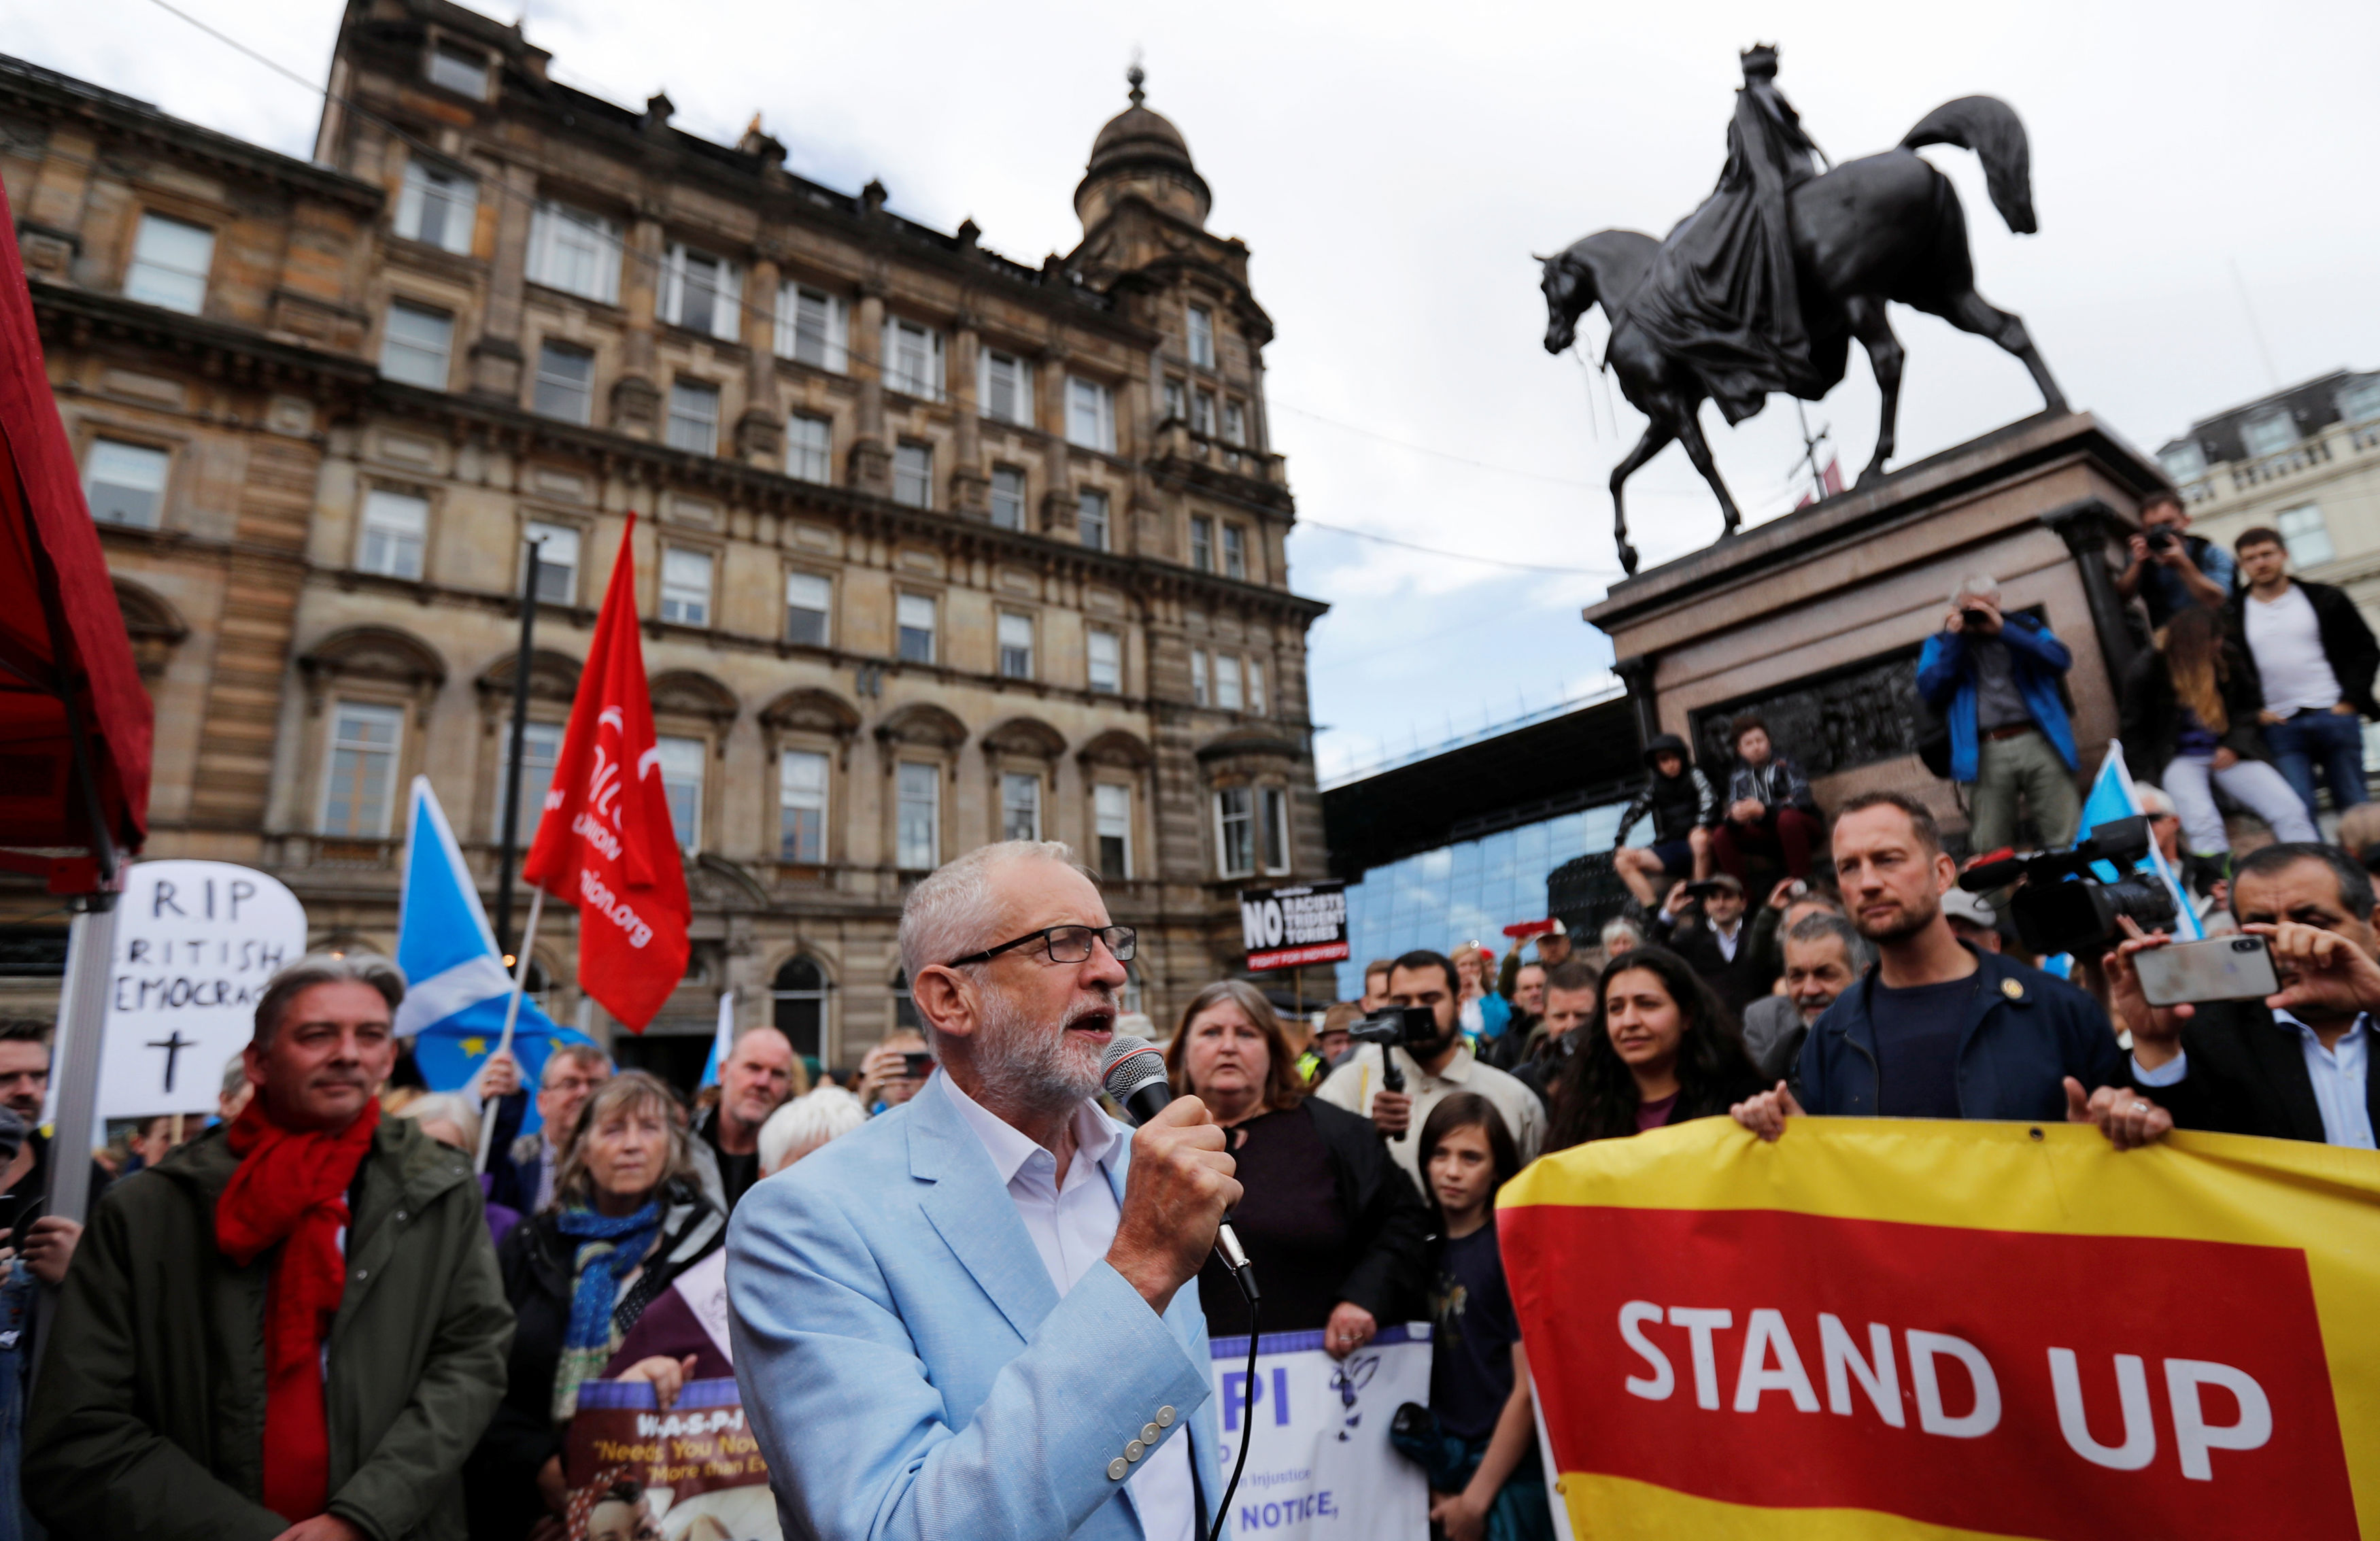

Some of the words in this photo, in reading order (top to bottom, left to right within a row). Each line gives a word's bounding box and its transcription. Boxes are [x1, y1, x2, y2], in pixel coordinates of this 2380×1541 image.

[153, 880, 257, 920] RIP
[1243, 898, 1283, 949] NO
[1284, 910, 1346, 928] TRIDENT
[1285, 924, 1338, 944] TORIES
[129, 938, 284, 971] RITISH
[1249, 954, 1280, 969] FIGHT
[1282, 951, 1302, 964] FOR
[1618, 1299, 2002, 1439] STAND
[2047, 1347, 2273, 1481] UP
[671, 1438, 712, 1459] You
[704, 1459, 743, 1478] than
[1252, 1468, 1312, 1489] Injustice
[1242, 1491, 1338, 1531] NOTICE,
